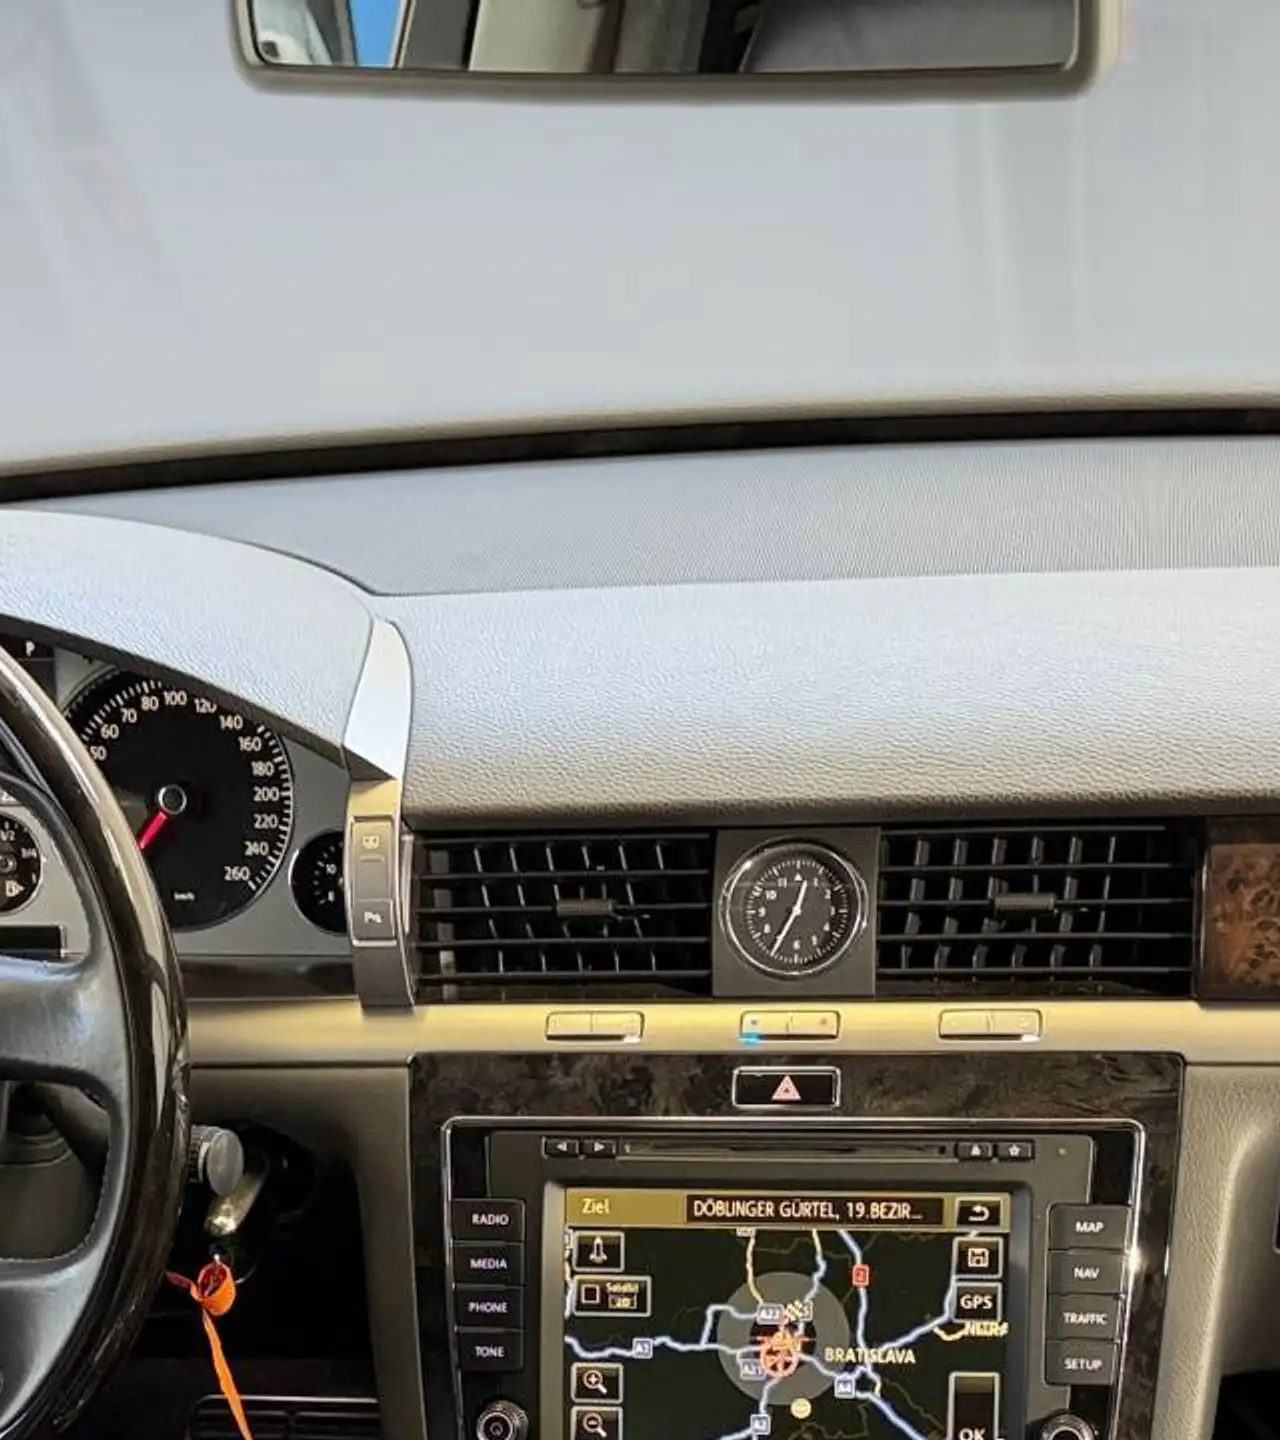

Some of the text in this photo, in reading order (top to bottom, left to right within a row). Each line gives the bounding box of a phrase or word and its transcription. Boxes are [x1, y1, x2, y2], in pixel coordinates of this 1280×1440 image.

[141, 696, 159, 711] 80
[164, 691, 187, 705] 100
[121, 708, 137, 723] 70
[220, 715, 243, 730] 140
[101, 724, 119, 739] 60
[238, 737, 261, 751] 160
[90, 746, 107, 761] 50
[251, 762, 274, 776] 180
[253, 786, 279, 801] 200
[254, 814, 278, 829] 220
[244, 841, 269, 856] 240
[224, 866, 249, 881] 260
[581, 1198, 610, 1215] Ziel
[779, 1198, 840, 1221] GÜRTEL,
[472, 1213, 509, 1226] RADIO
[1075, 1221, 1104, 1233] MAP
[470, 1257, 507, 1270] MEDIA
[1073, 1267, 1099, 1279] NAV
[469, 1300, 508, 1314] PHONE
[960, 1295, 993, 1309] GPS
[1063, 1312, 1108, 1325] TRAFFIC
[475, 1345, 504, 1358] TONE
[824, 1348, 916, 1364] BRATISLAVA
[1064, 1358, 1102, 1370] SETUP
